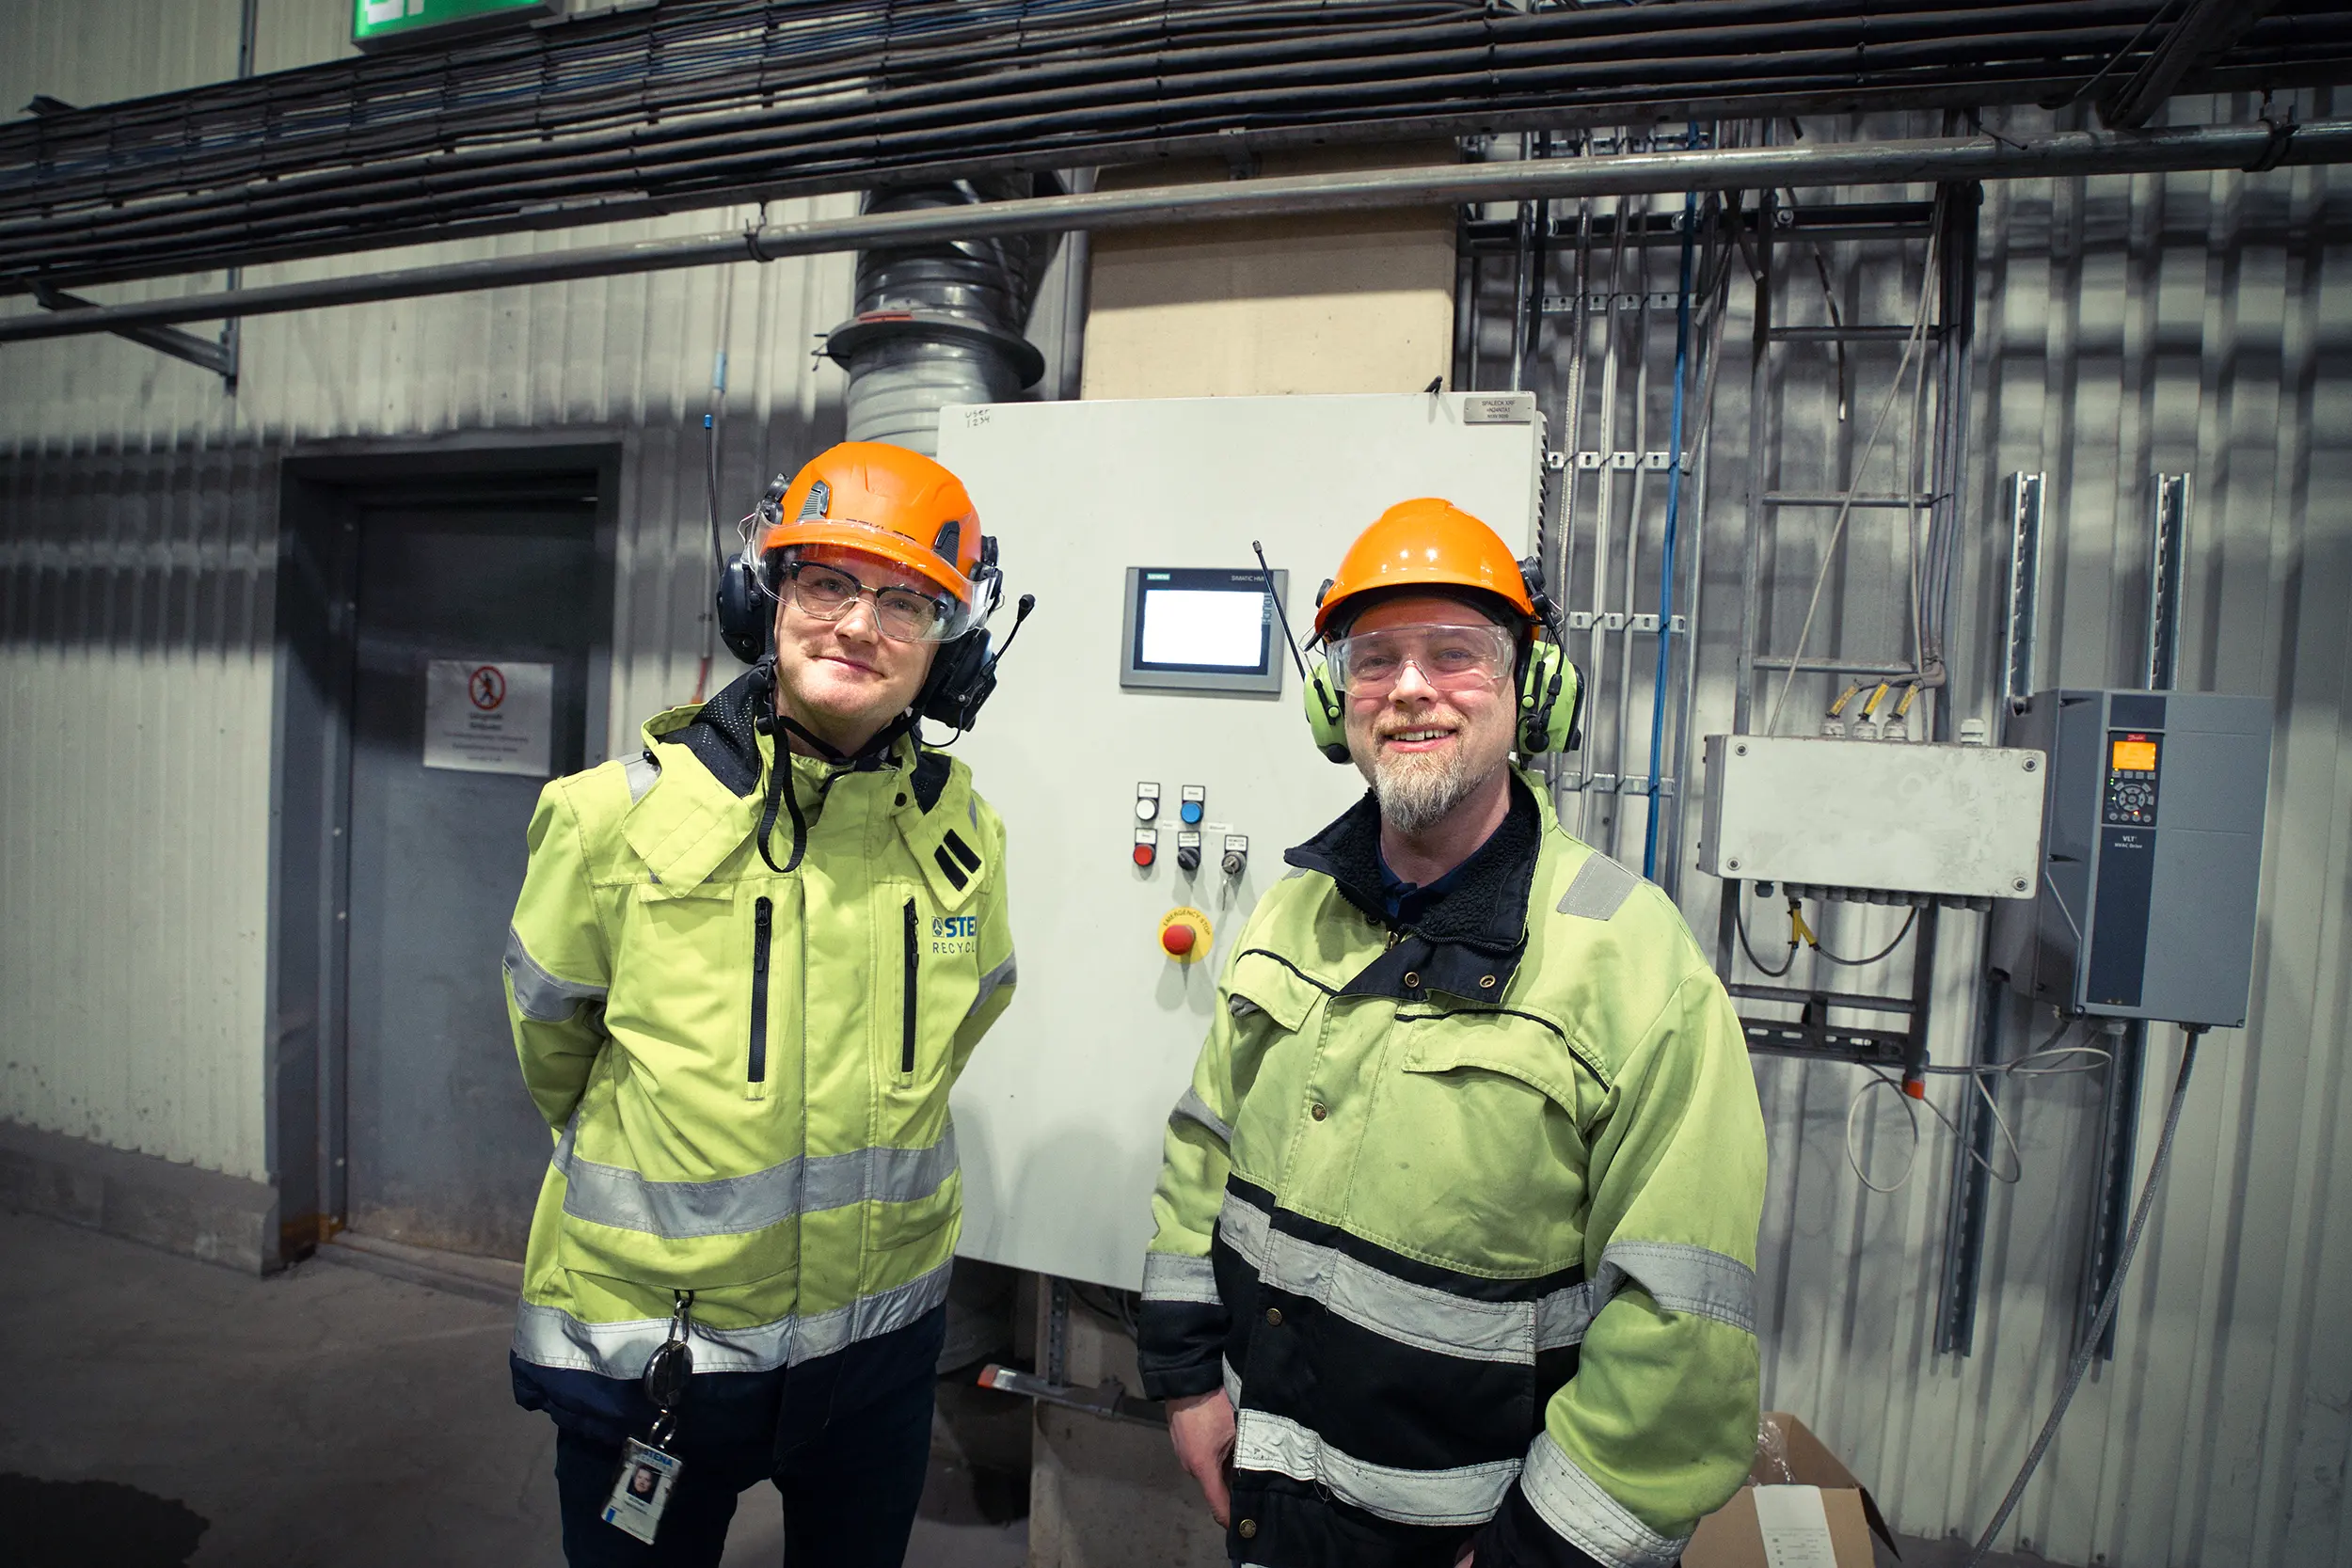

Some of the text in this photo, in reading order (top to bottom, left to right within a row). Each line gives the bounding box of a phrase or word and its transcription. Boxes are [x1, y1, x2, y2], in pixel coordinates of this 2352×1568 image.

[967, 416, 990, 428] 1234
[1163, 910, 1211, 936] EMERGENCY STOP
[932, 942, 976, 954] RECYCL
